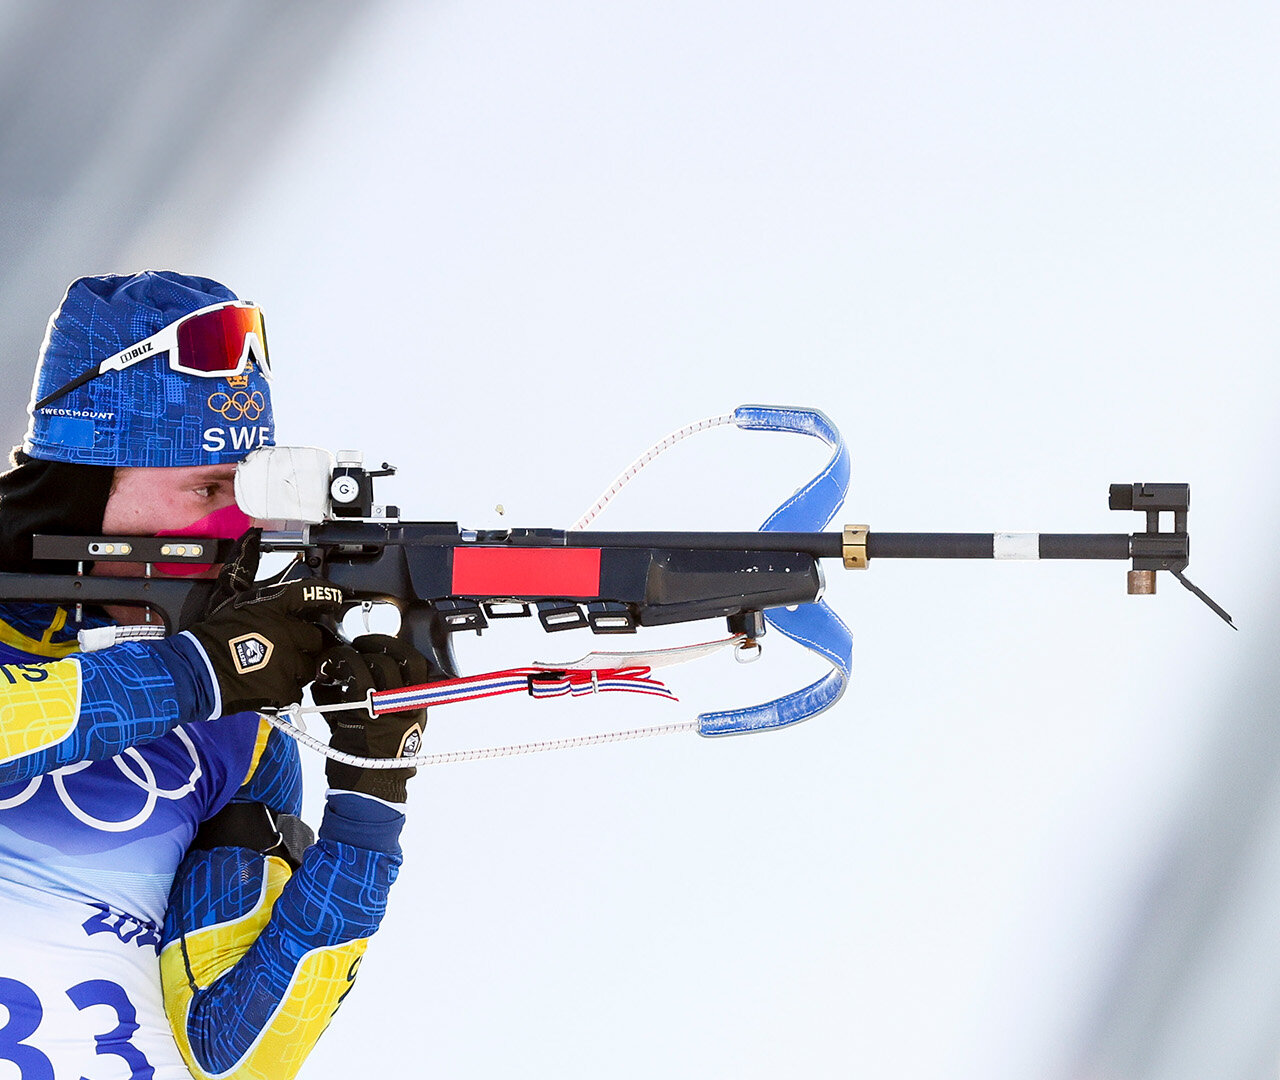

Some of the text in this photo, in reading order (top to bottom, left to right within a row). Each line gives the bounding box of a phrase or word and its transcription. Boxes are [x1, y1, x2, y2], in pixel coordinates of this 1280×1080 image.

[131, 342, 154, 358] BLIZ
[40, 407, 115, 420] SWEDEMOUNT
[203, 427, 270, 452] SWE
[339, 484, 349, 494] G
